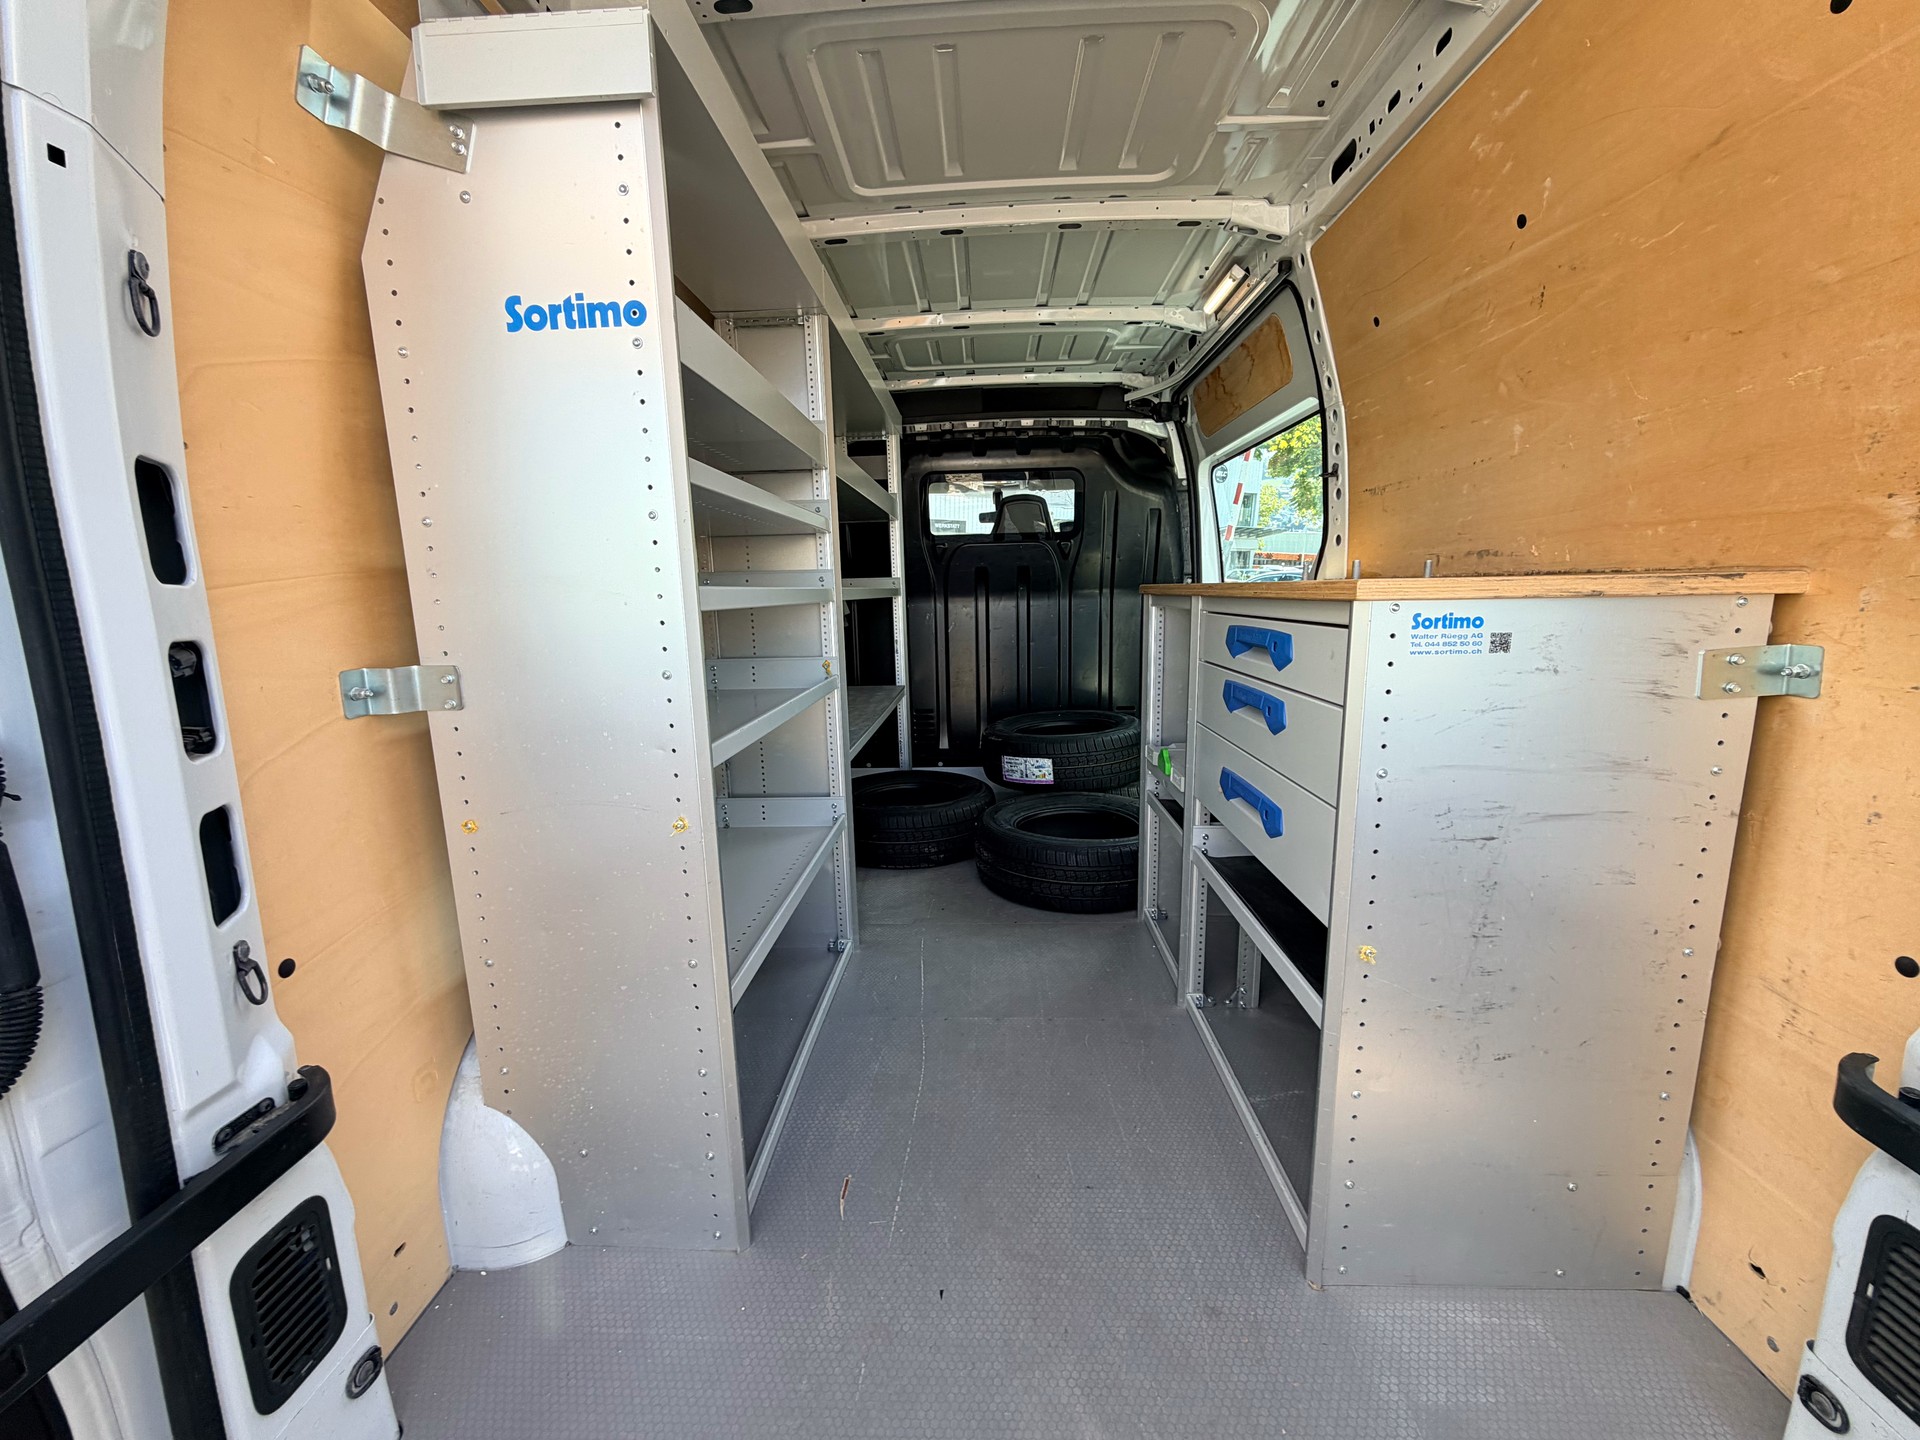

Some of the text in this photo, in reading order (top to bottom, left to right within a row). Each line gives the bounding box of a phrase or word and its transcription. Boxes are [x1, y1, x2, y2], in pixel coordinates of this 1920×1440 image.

[504, 292, 647, 333] Sortimo
[1411, 612, 1485, 630] Sortimo
[1440, 632, 1469, 640] Rüegg
[1409, 648, 1483, 656] www.sortimo.ch
